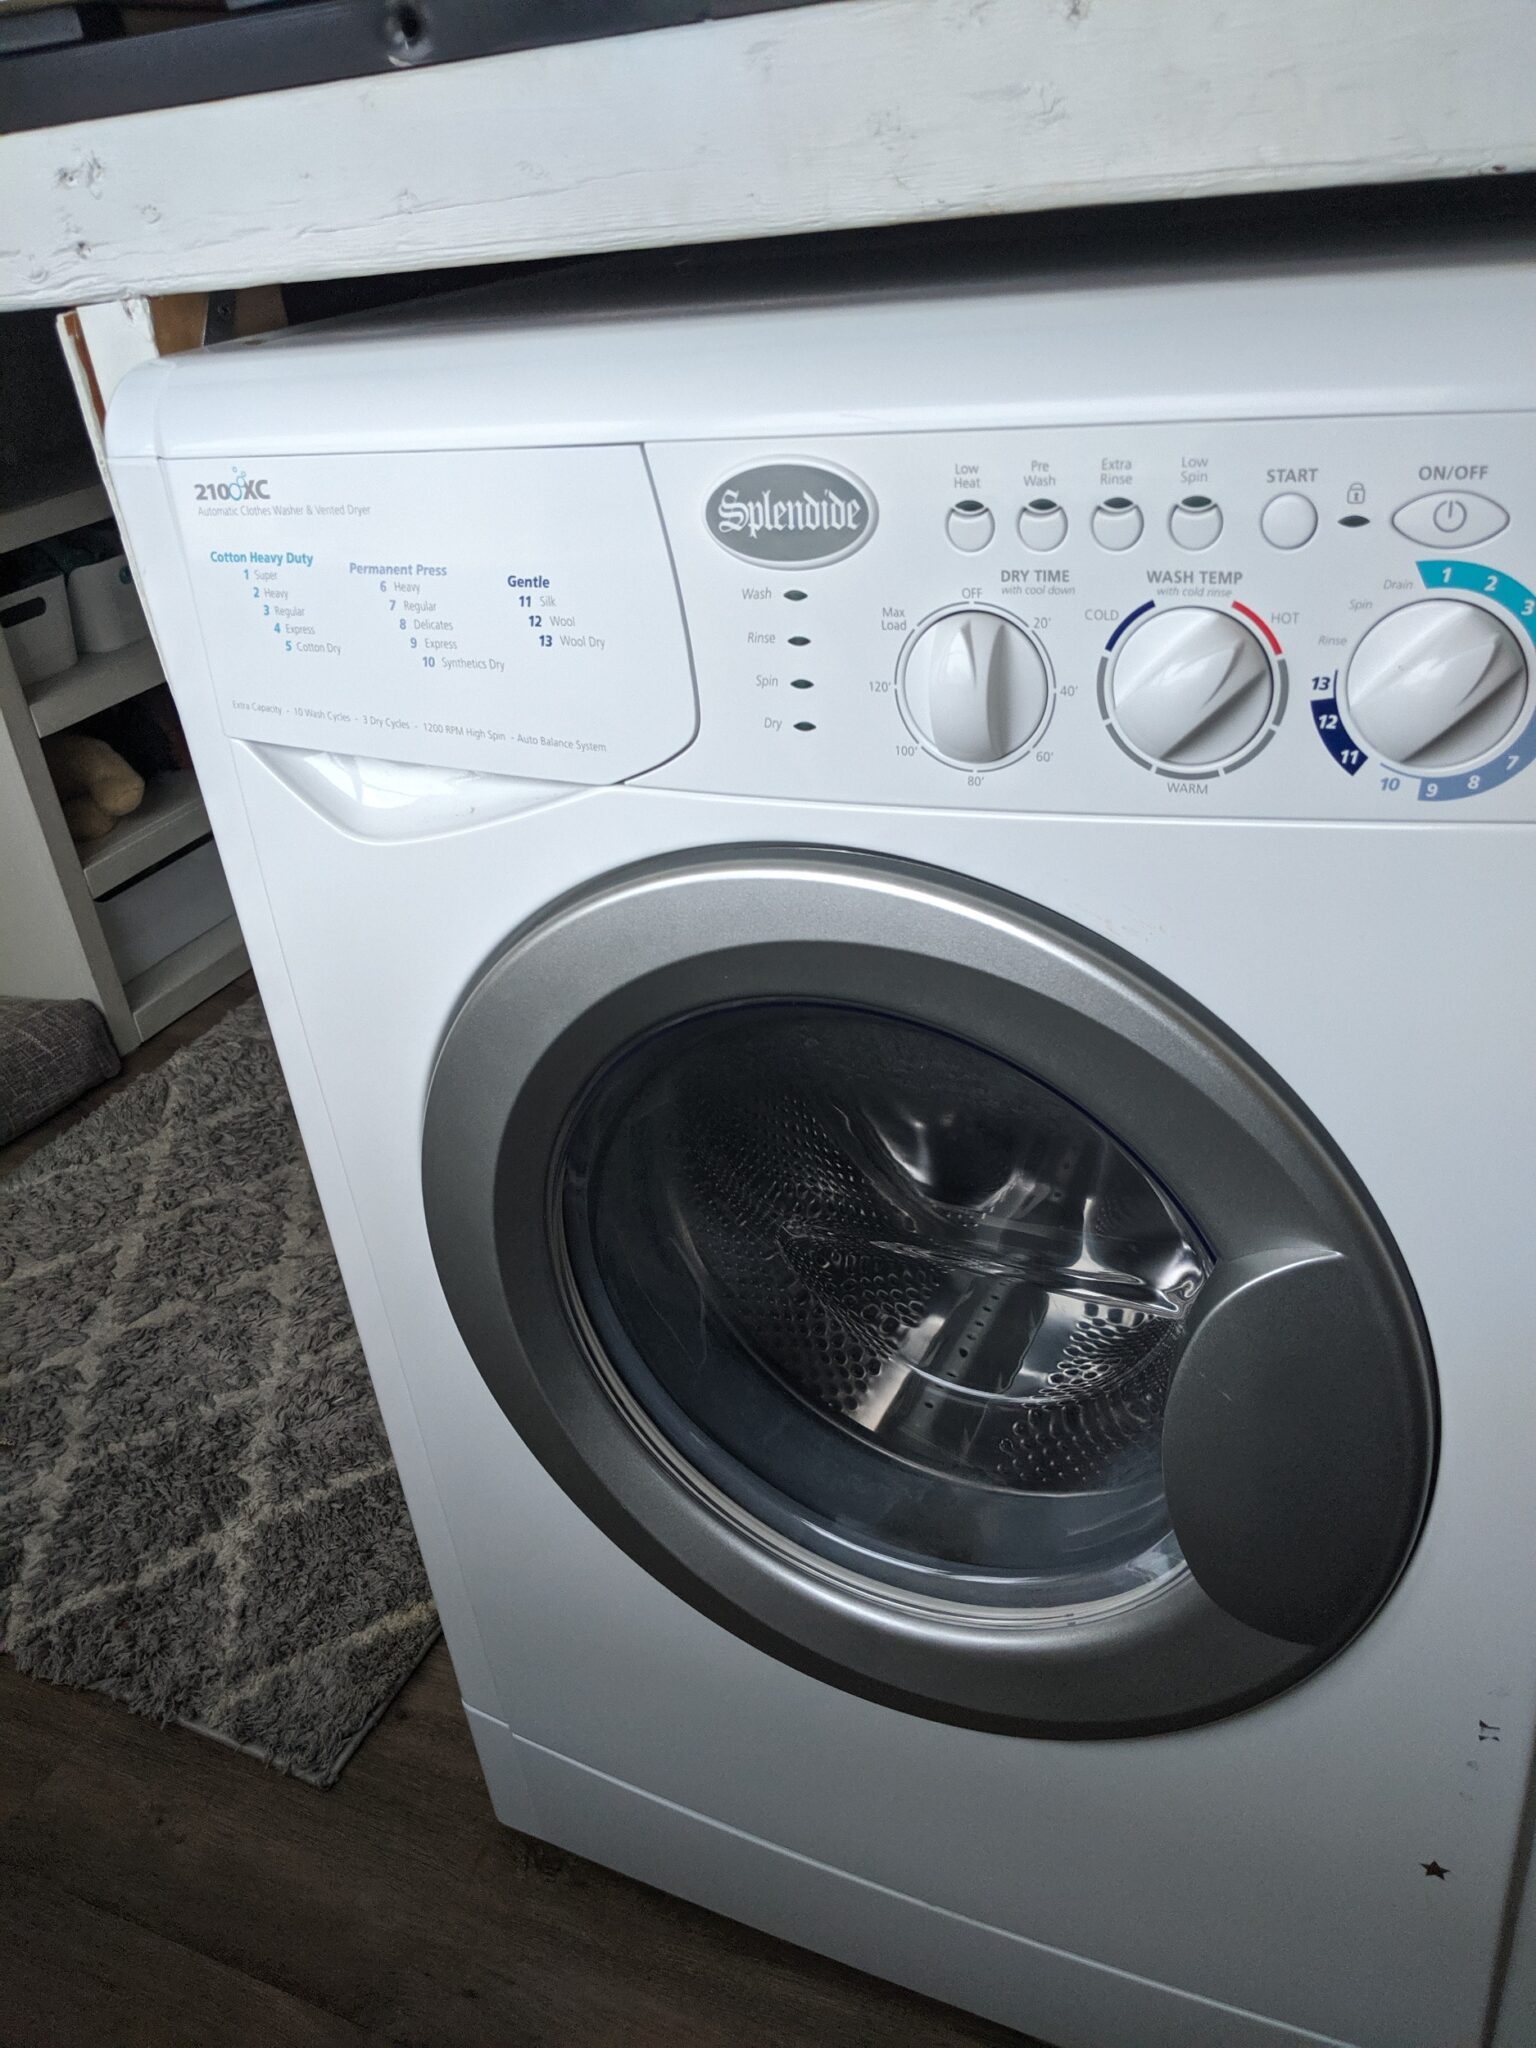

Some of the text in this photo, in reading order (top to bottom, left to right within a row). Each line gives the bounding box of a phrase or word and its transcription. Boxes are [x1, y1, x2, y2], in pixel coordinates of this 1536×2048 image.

[1031, 460, 1049, 472] Pre
[1101, 458, 1132, 471] Extra
[1181, 457, 1208, 468] Low
[955, 464, 979, 475] Low
[1266, 468, 1318, 483] START
[1418, 466, 1488, 481] ON/OFF
[954, 478, 981, 489] Heat
[1024, 475, 1056, 486] Wash
[1100, 473, 1132, 485] Rinse
[1180, 471, 1208, 484] Spin
[198, 504, 370, 516] Automatic Clothes Washer & Vented Dryer
[718, 488, 861, 539] Splendide
[210, 551, 314, 567] Cotton Heavy Duty
[244, 570, 277, 581] 1 Super
[350, 562, 447, 576] Permanent Press
[1442, 568, 1452, 583] 1
[508, 575, 549, 588] Gentle
[1001, 570, 1070, 582] DRY TIME
[1147, 571, 1243, 585] WASH TEMP
[380, 581, 420, 595] 6 Heavy
[1383, 579, 1413, 590] Drain
[1484, 576, 1498, 591] 2
[253, 587, 288, 600] 2 Heavy
[742, 588, 772, 599] Wash
[962, 588, 982, 599] OFF
[1002, 586, 1075, 595] with cool down
[1156, 588, 1232, 597] with cold rinse
[390, 600, 436, 614] 7 Regular
[519, 596, 556, 607] 11 Silk
[1349, 599, 1373, 612] Spin
[1521, 600, 1535, 616] 3
[264, 605, 304, 618] 3 Regular
[882, 607, 905, 618] Max
[1084, 609, 1119, 621] COLD
[400, 618, 453, 630] 8 Delicates
[529, 616, 575, 627] 12 Wool
[1271, 613, 1299, 624] HOT
[274, 623, 315, 636] 4 Express
[882, 620, 906, 631] Load
[410, 638, 457, 650] 9 Express
[539, 635, 605, 650] 13 Wool Dry
[747, 632, 776, 644] Rinse
[1318, 635, 1347, 646] Rinse
[286, 641, 341, 655] 5 Cotton Dry
[423, 656, 505, 672] 10 Synthetics Dry
[756, 675, 778, 688] Spin
[1311, 677, 1330, 691] 13
[232, 700, 250, 710] Extra
[252, 702, 282, 715] Capacity
[294, 708, 303, 717] 10
[304, 708, 325, 720] Wash
[327, 712, 351, 722] Cycles
[362, 716, 368, 724] 3
[370, 716, 383, 728] Dry
[385, 718, 410, 730] Cycles
[423, 722, 443, 734] 1200
[446, 725, 464, 736] RPM
[466, 728, 486, 740] High
[488, 730, 505, 742] Spin
[517, 734, 538, 745] Auto
[541, 736, 573, 749] Balance
[576, 740, 606, 752] System
[764, 717, 782, 730] Dry
[1318, 715, 1338, 729] 12
[1340, 750, 1359, 764] 11
[1506, 756, 1519, 770] 7
[1168, 783, 1208, 794] WARM
[1380, 778, 1400, 791] 10
[1468, 776, 1480, 790] 8
[1426, 784, 1438, 797] 9
